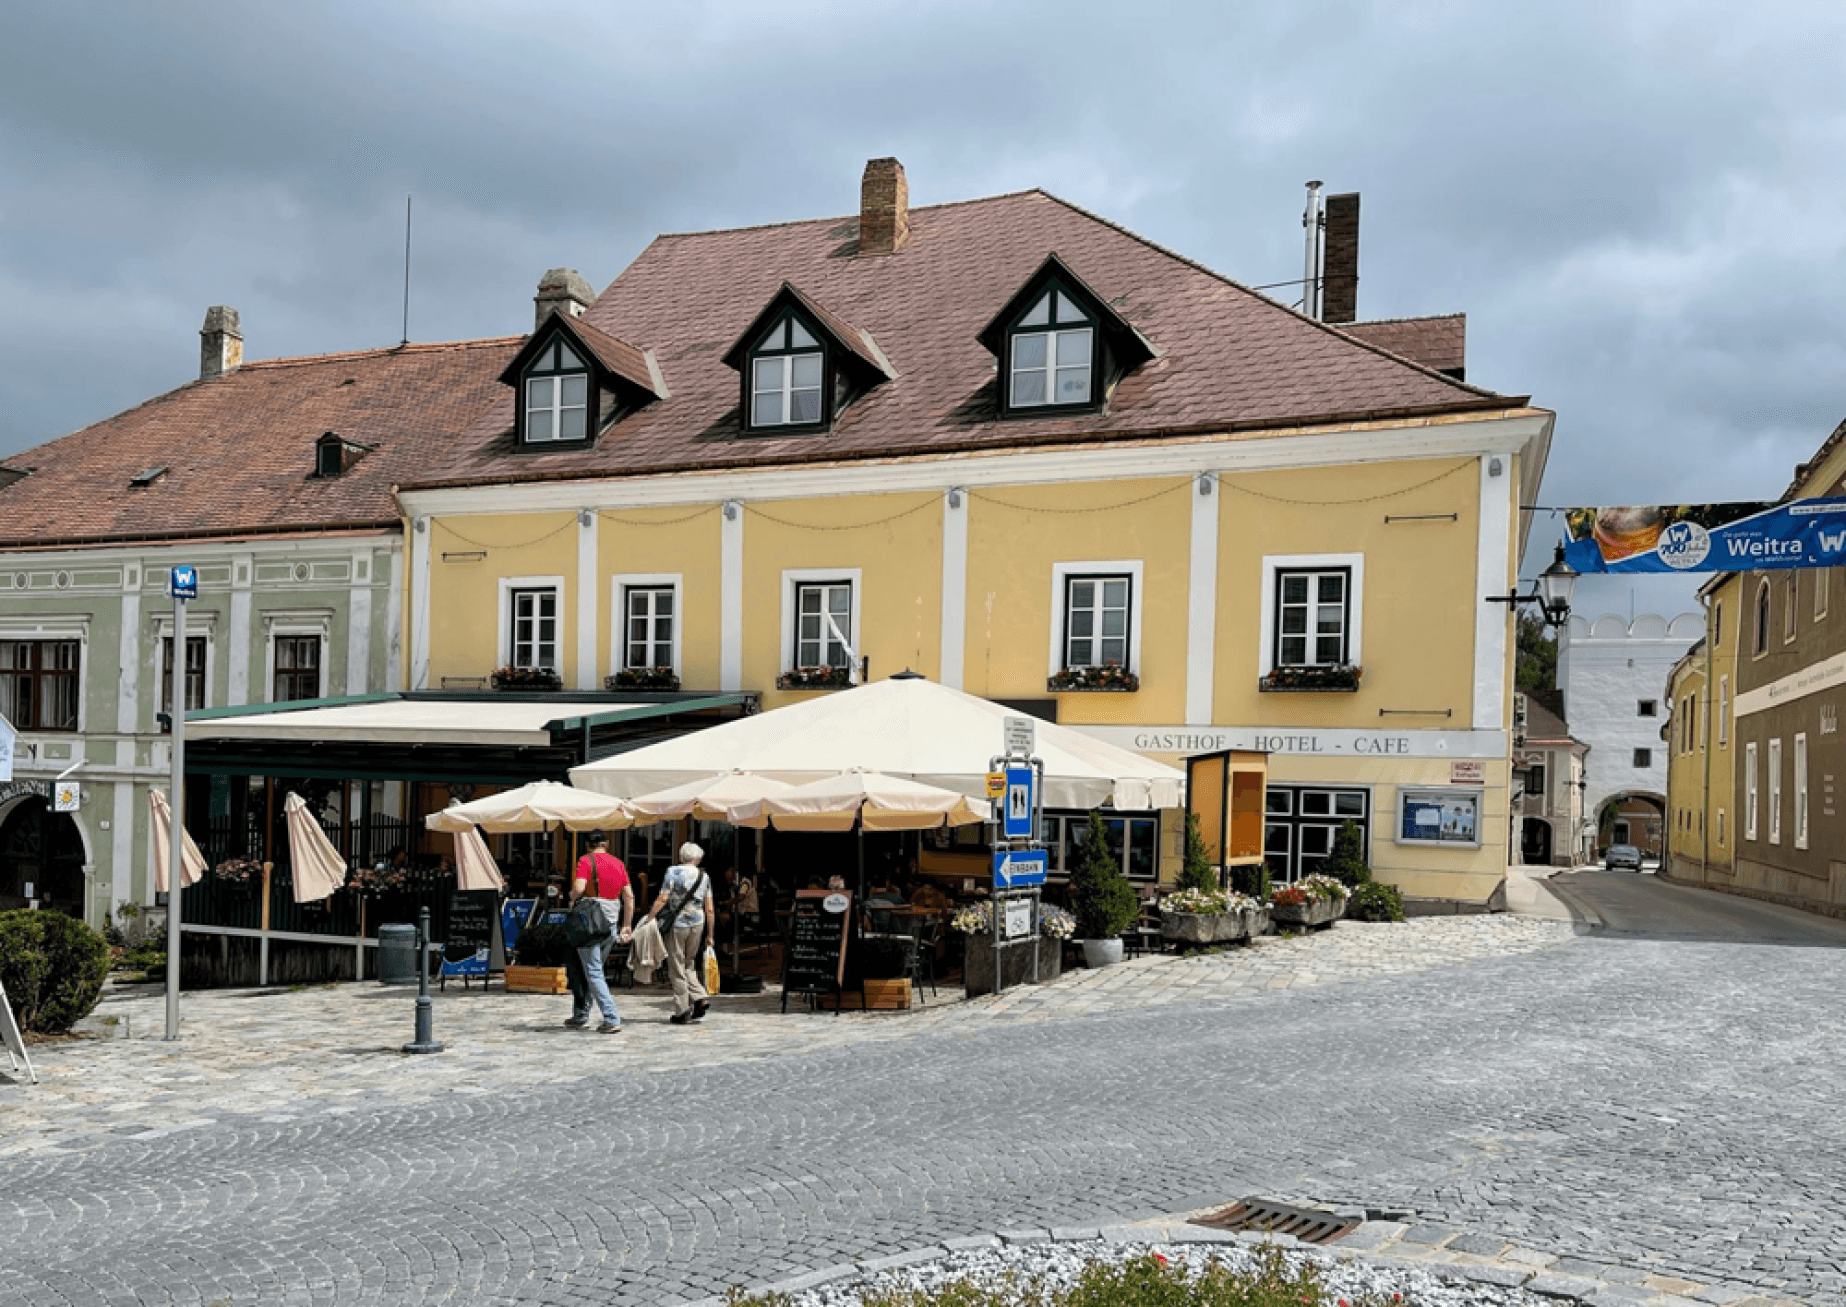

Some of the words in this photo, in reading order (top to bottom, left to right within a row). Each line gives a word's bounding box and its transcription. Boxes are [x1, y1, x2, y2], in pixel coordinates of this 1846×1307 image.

[1727, 536, 1803, 557] Weitra
[1134, 733, 1227, 750] GASTHOF
[1254, 735, 1323, 752] HOTEL
[1352, 737, 1410, 754] CAFE
